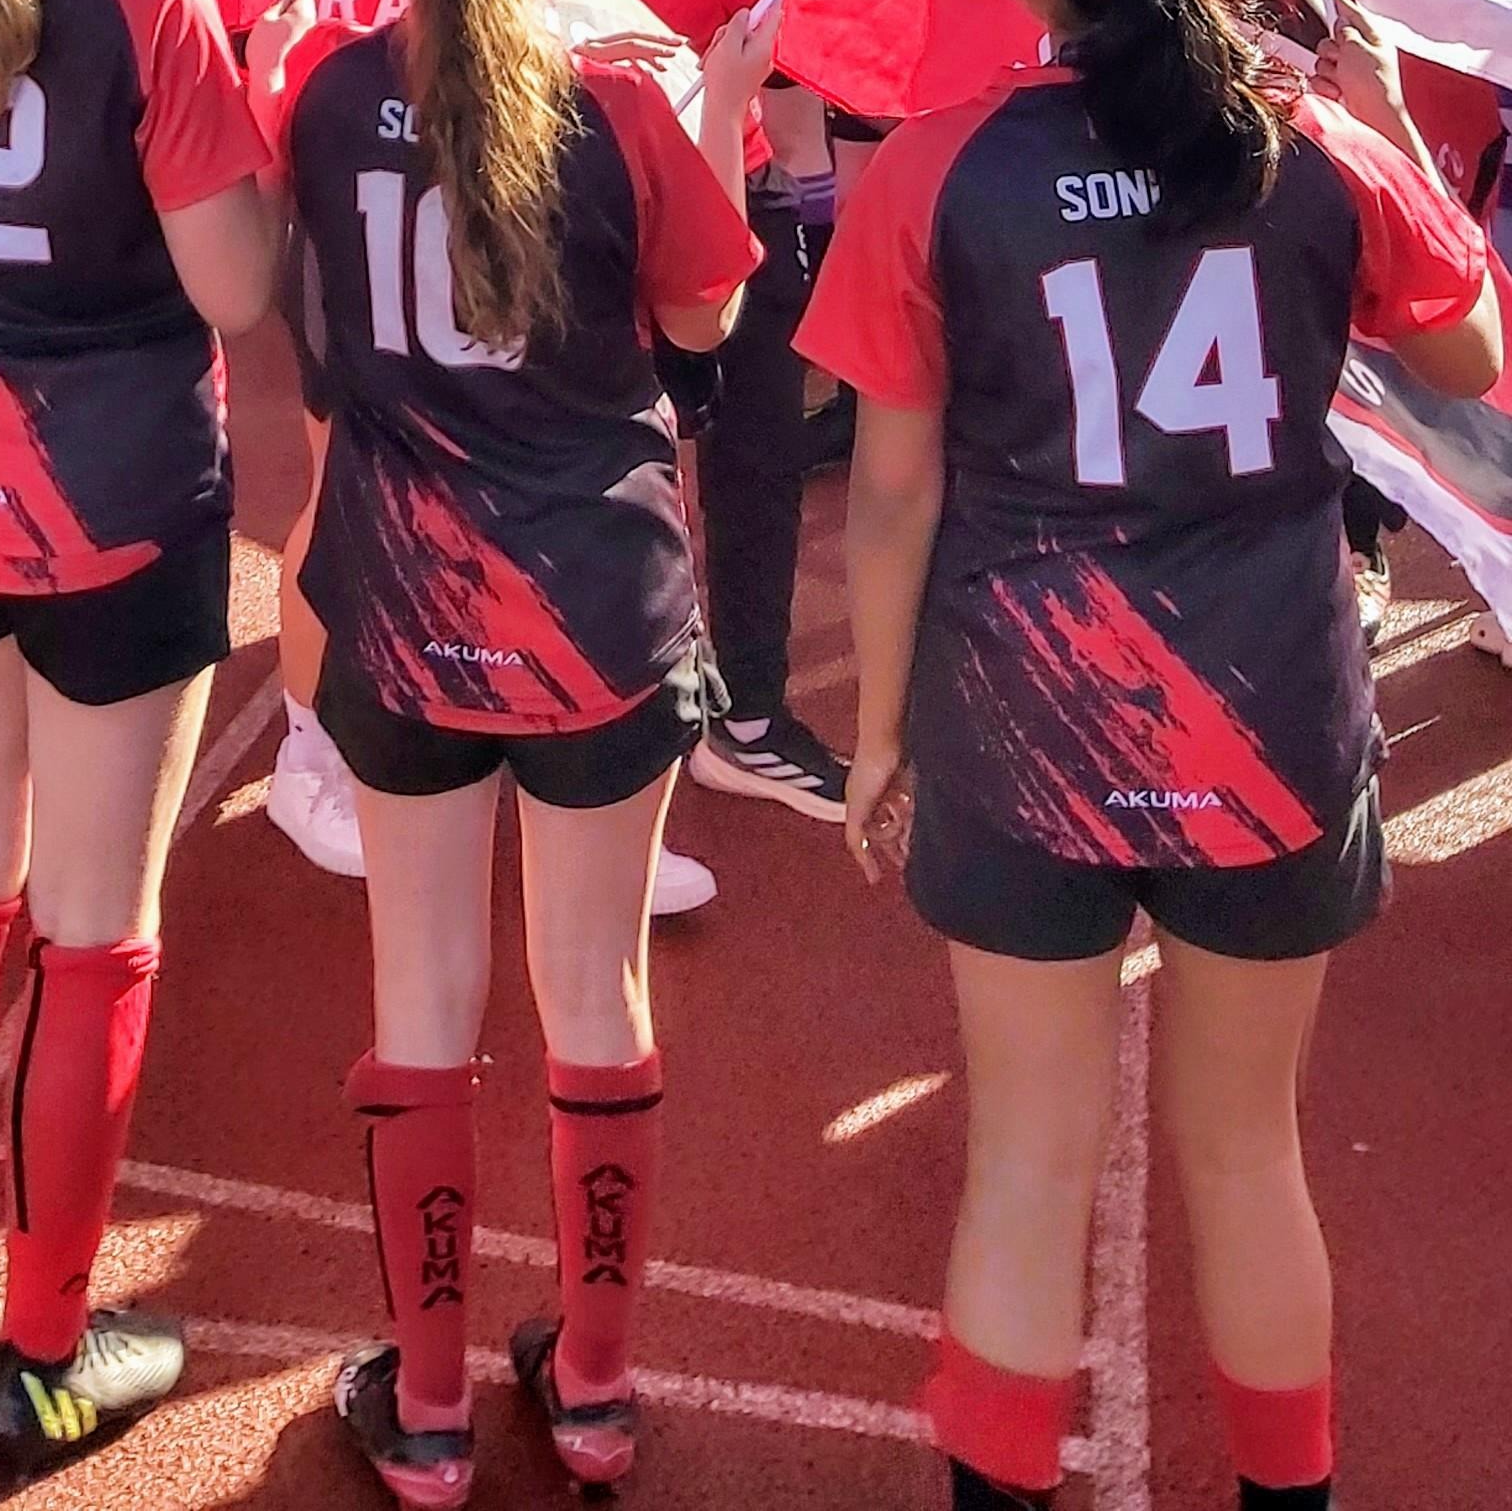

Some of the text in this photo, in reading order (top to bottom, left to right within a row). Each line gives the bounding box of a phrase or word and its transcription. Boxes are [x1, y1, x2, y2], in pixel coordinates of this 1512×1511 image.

[356, 169, 527, 371] 10
[1041, 246, 1281, 485] 14
[423, 640, 524, 666] AKUMA
[1103, 789, 1224, 809] AKUMA
[416, 1185, 466, 1311] AKUMA
[579, 1163, 635, 1287] AKUMA
